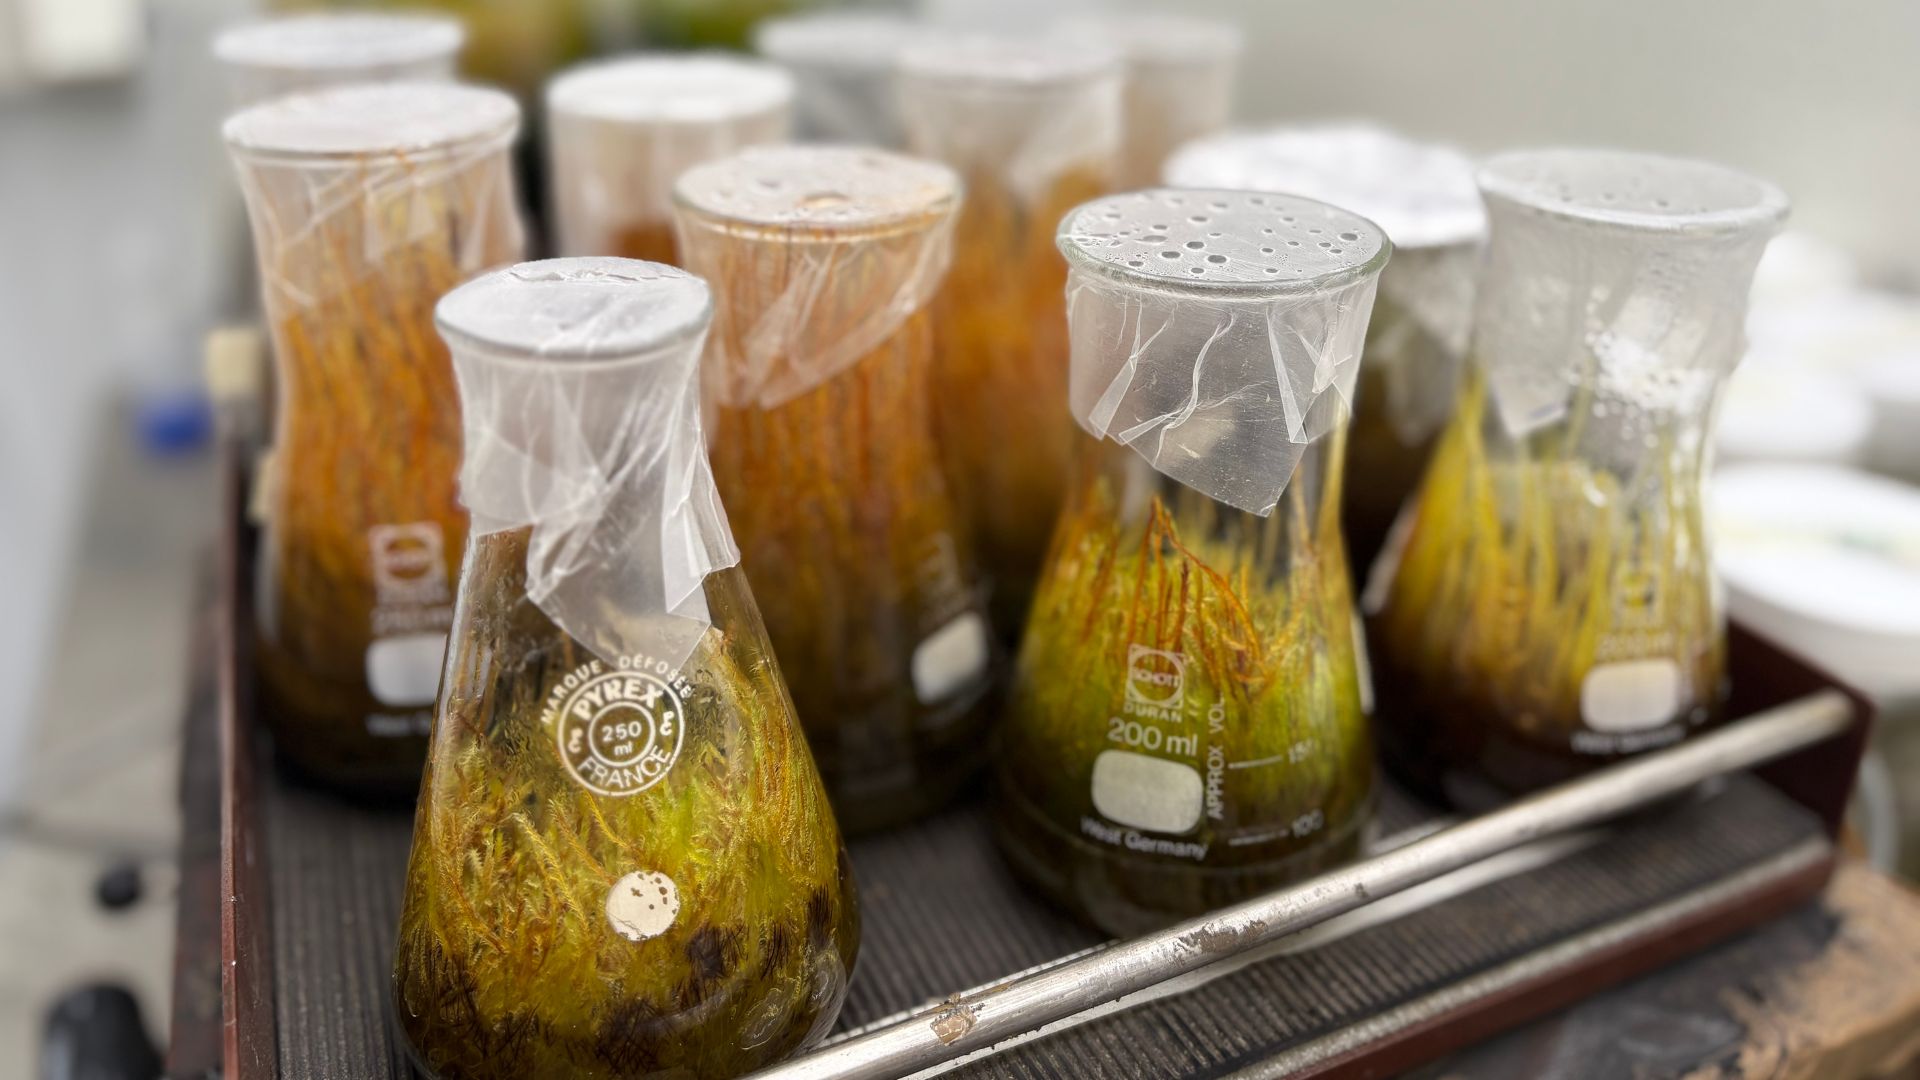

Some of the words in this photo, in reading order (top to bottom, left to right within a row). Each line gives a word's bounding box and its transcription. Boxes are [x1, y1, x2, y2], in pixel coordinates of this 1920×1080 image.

[541, 659, 602, 724] MARQUE
[572, 679, 664, 721] PYREX
[1123, 701, 1182, 723] DURAN
[602, 721, 642, 743] 250
[614, 741, 633, 756] ml
[1107, 717, 1162, 750] 200
[1166, 734, 1198, 757] ml
[577, 745, 672, 789] FRANCE
[1206, 745, 1225, 820] APPROX
[1080, 817, 1121, 846] West
[1124, 831, 1209, 862] Germany
